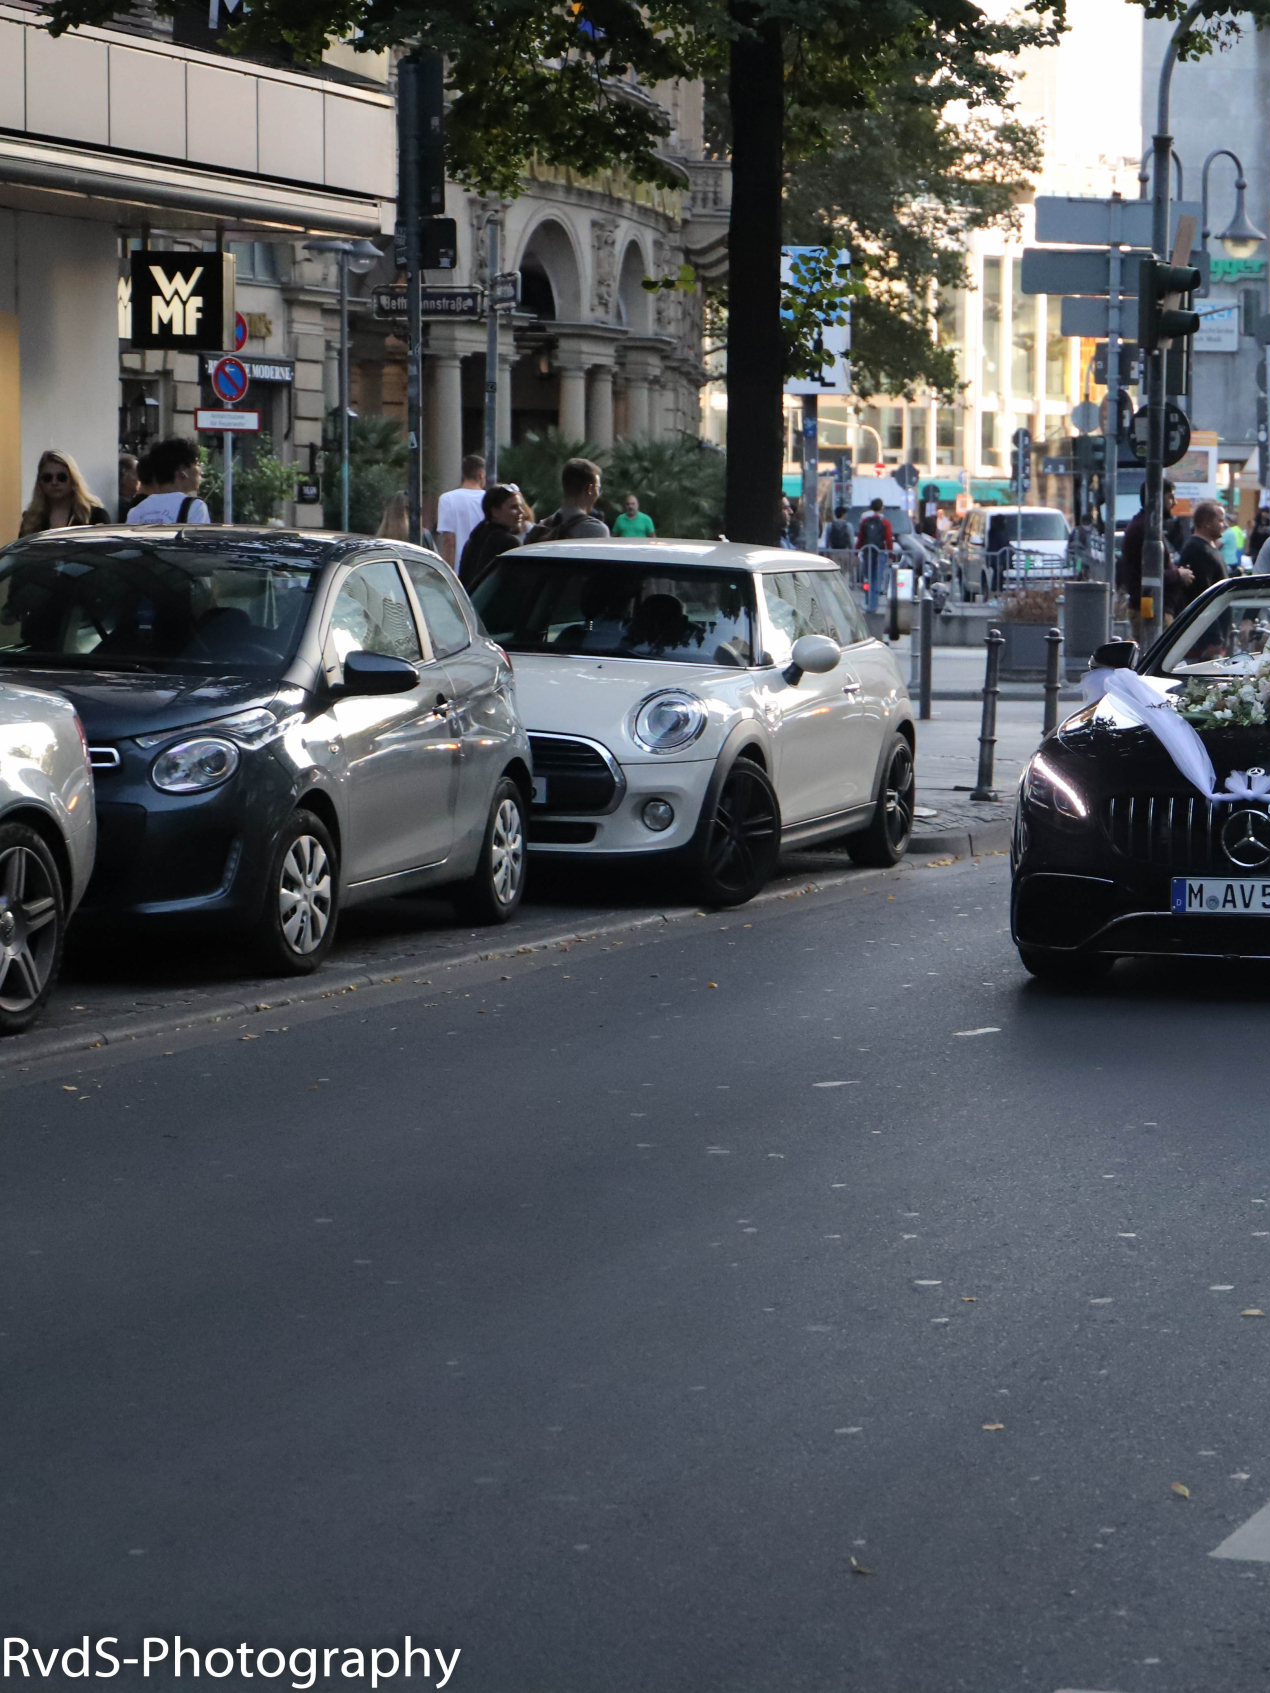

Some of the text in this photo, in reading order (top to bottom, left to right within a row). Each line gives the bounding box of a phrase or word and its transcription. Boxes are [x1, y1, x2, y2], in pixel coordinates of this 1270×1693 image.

[384, 296, 469, 313] Bethnnstraße
[251, 363, 292, 381] MODERNE
[1188, 883, 1203, 908] M
[1222, 883, 1255, 909] AV
